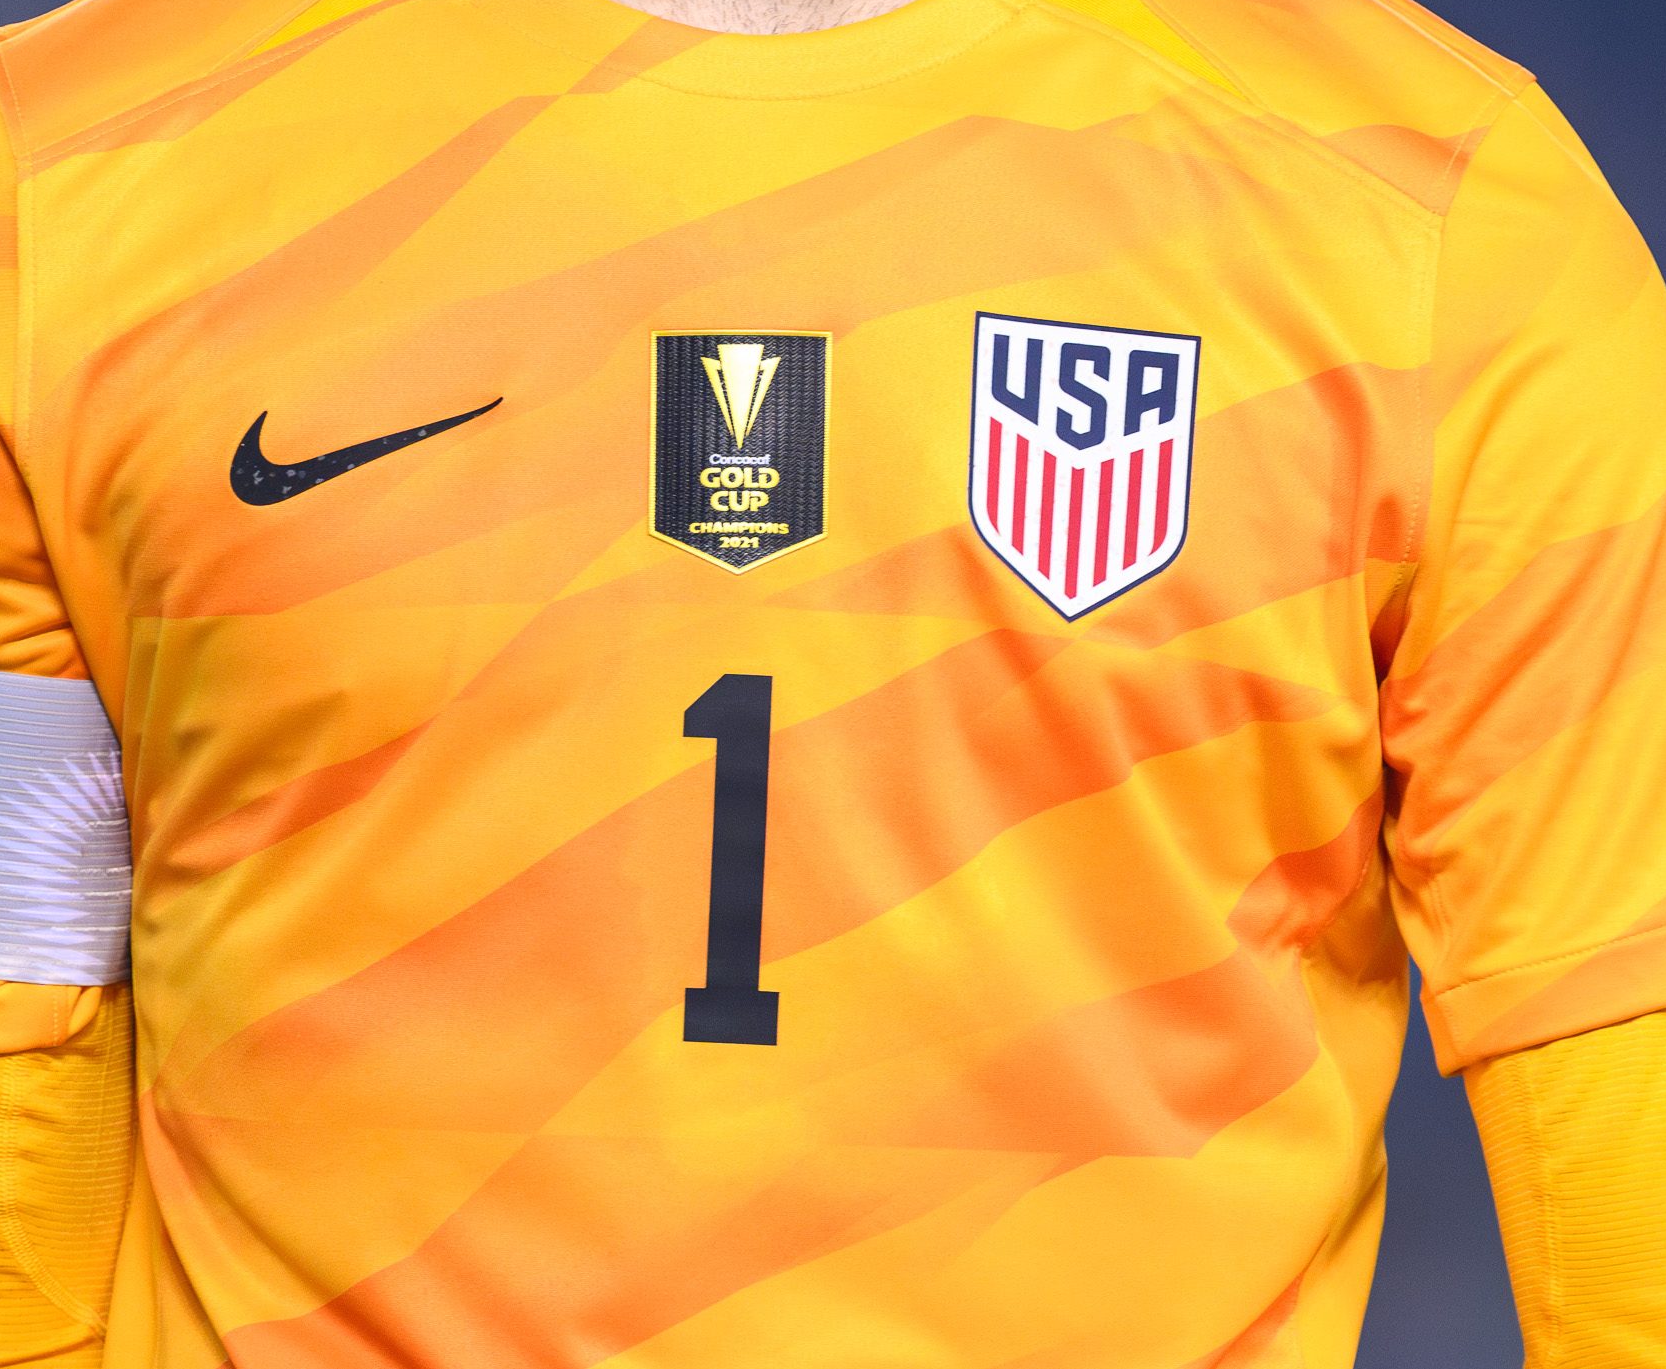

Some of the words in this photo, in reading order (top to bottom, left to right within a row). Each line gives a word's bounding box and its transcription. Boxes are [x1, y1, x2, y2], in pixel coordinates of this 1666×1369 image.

[991, 333, 1180, 450] USA
[709, 454, 771, 464] Concacaf
[699, 466, 780, 488] GOLD
[710, 490, 770, 512] CUP
[689, 521, 790, 534] CHAMPIONS
[719, 536, 760, 549] 2021
[683, 673, 780, 1046] 1
